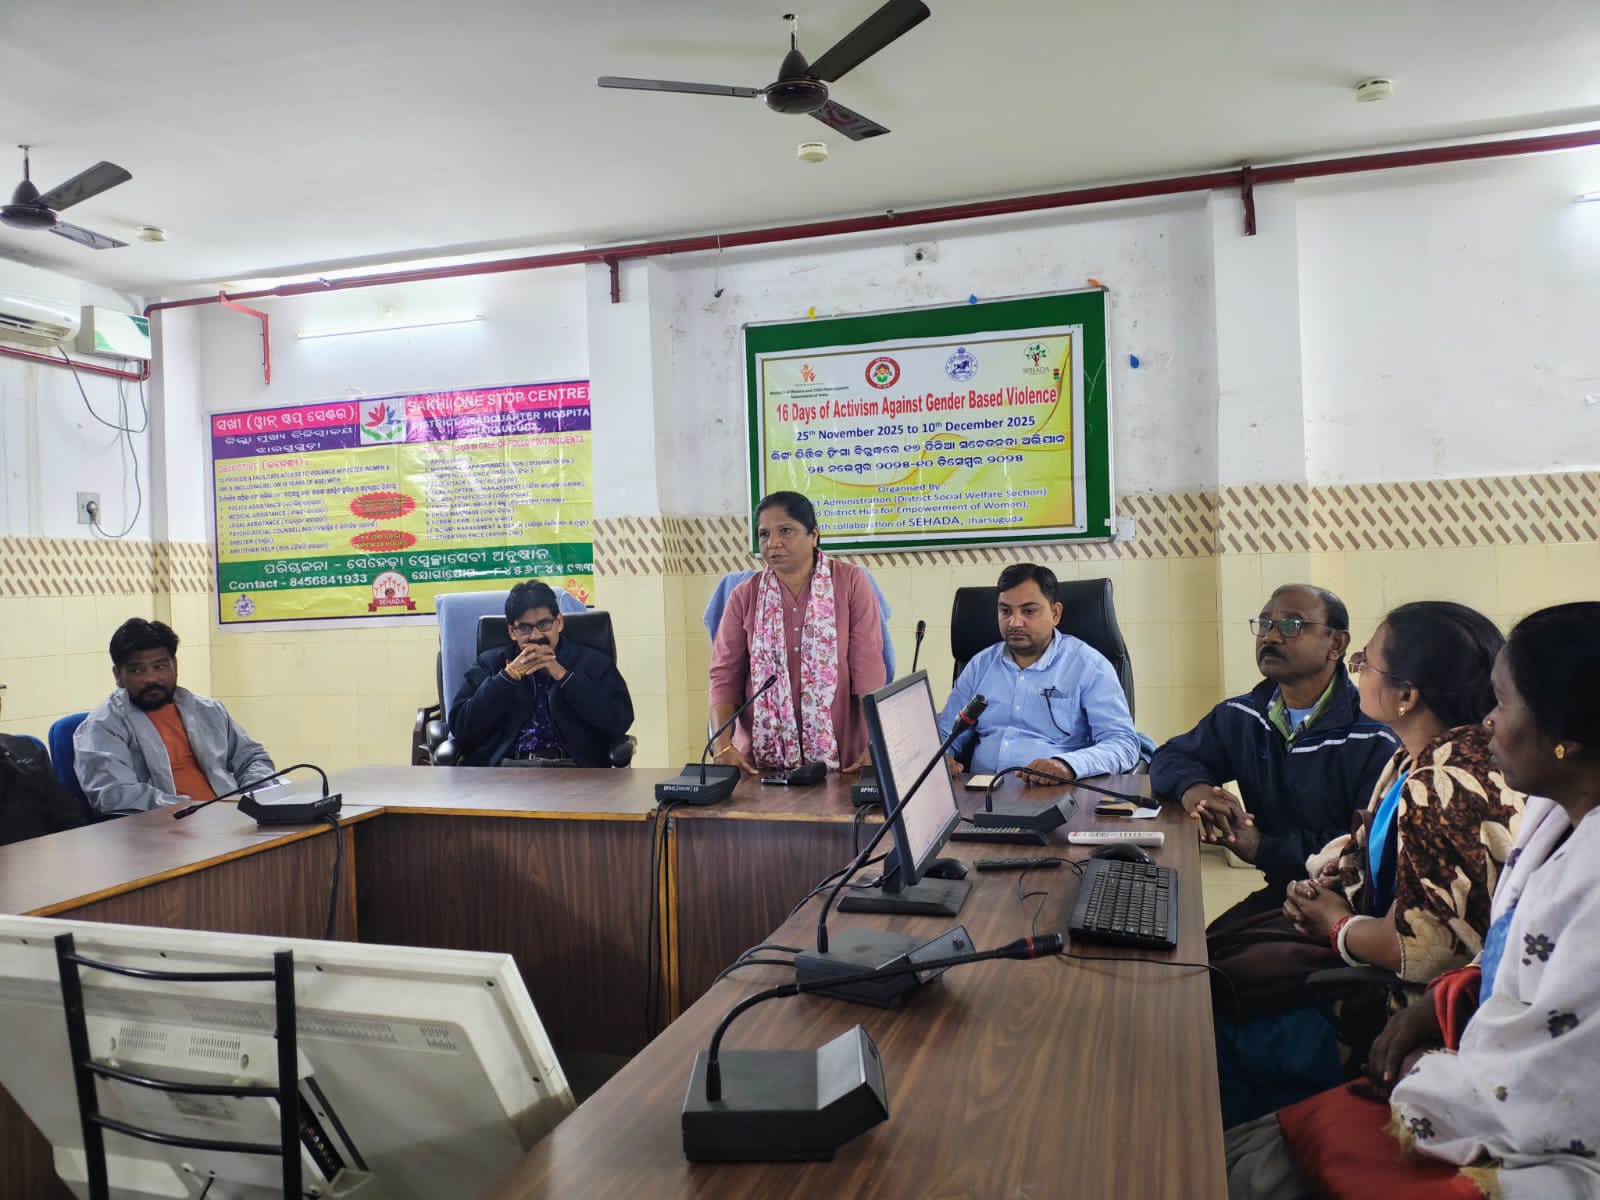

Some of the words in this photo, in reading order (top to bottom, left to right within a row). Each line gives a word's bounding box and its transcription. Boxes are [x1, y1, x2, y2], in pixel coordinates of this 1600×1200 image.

[487, 391, 525, 406] STOP
[777, 403, 788, 422] 16
[792, 402, 816, 424] Days
[820, 400, 830, 419] of
[834, 399, 878, 418] Activism
[882, 394, 922, 419] Against
[926, 390, 965, 412] Gender
[968, 387, 1003, 409] Based
[1006, 384, 1057, 405] Violence
[544, 408, 590, 419] HOSPITA
[797, 430, 816, 441] 25th
[818, 427, 874, 440] November
[878, 425, 904, 436] 2025
[908, 425, 919, 434] to
[922, 421, 942, 432] 10th
[946, 418, 1003, 431] December
[1007, 416, 1035, 427] 2025
[878, 484, 926, 494] Organised
[824, 496, 891, 506] Administration
[894, 494, 930, 504] (District
[934, 492, 962, 501] Social
[966, 491, 1003, 499] Welfare
[1006, 488, 1046, 497] Section)
[897, 504, 967, 514] Empowerment
[833, 520, 893, 530] collaboration
[909, 516, 963, 527] SEHADA,
[229, 580, 278, 590] Contact
[290, 574, 368, 587] 8456841933
